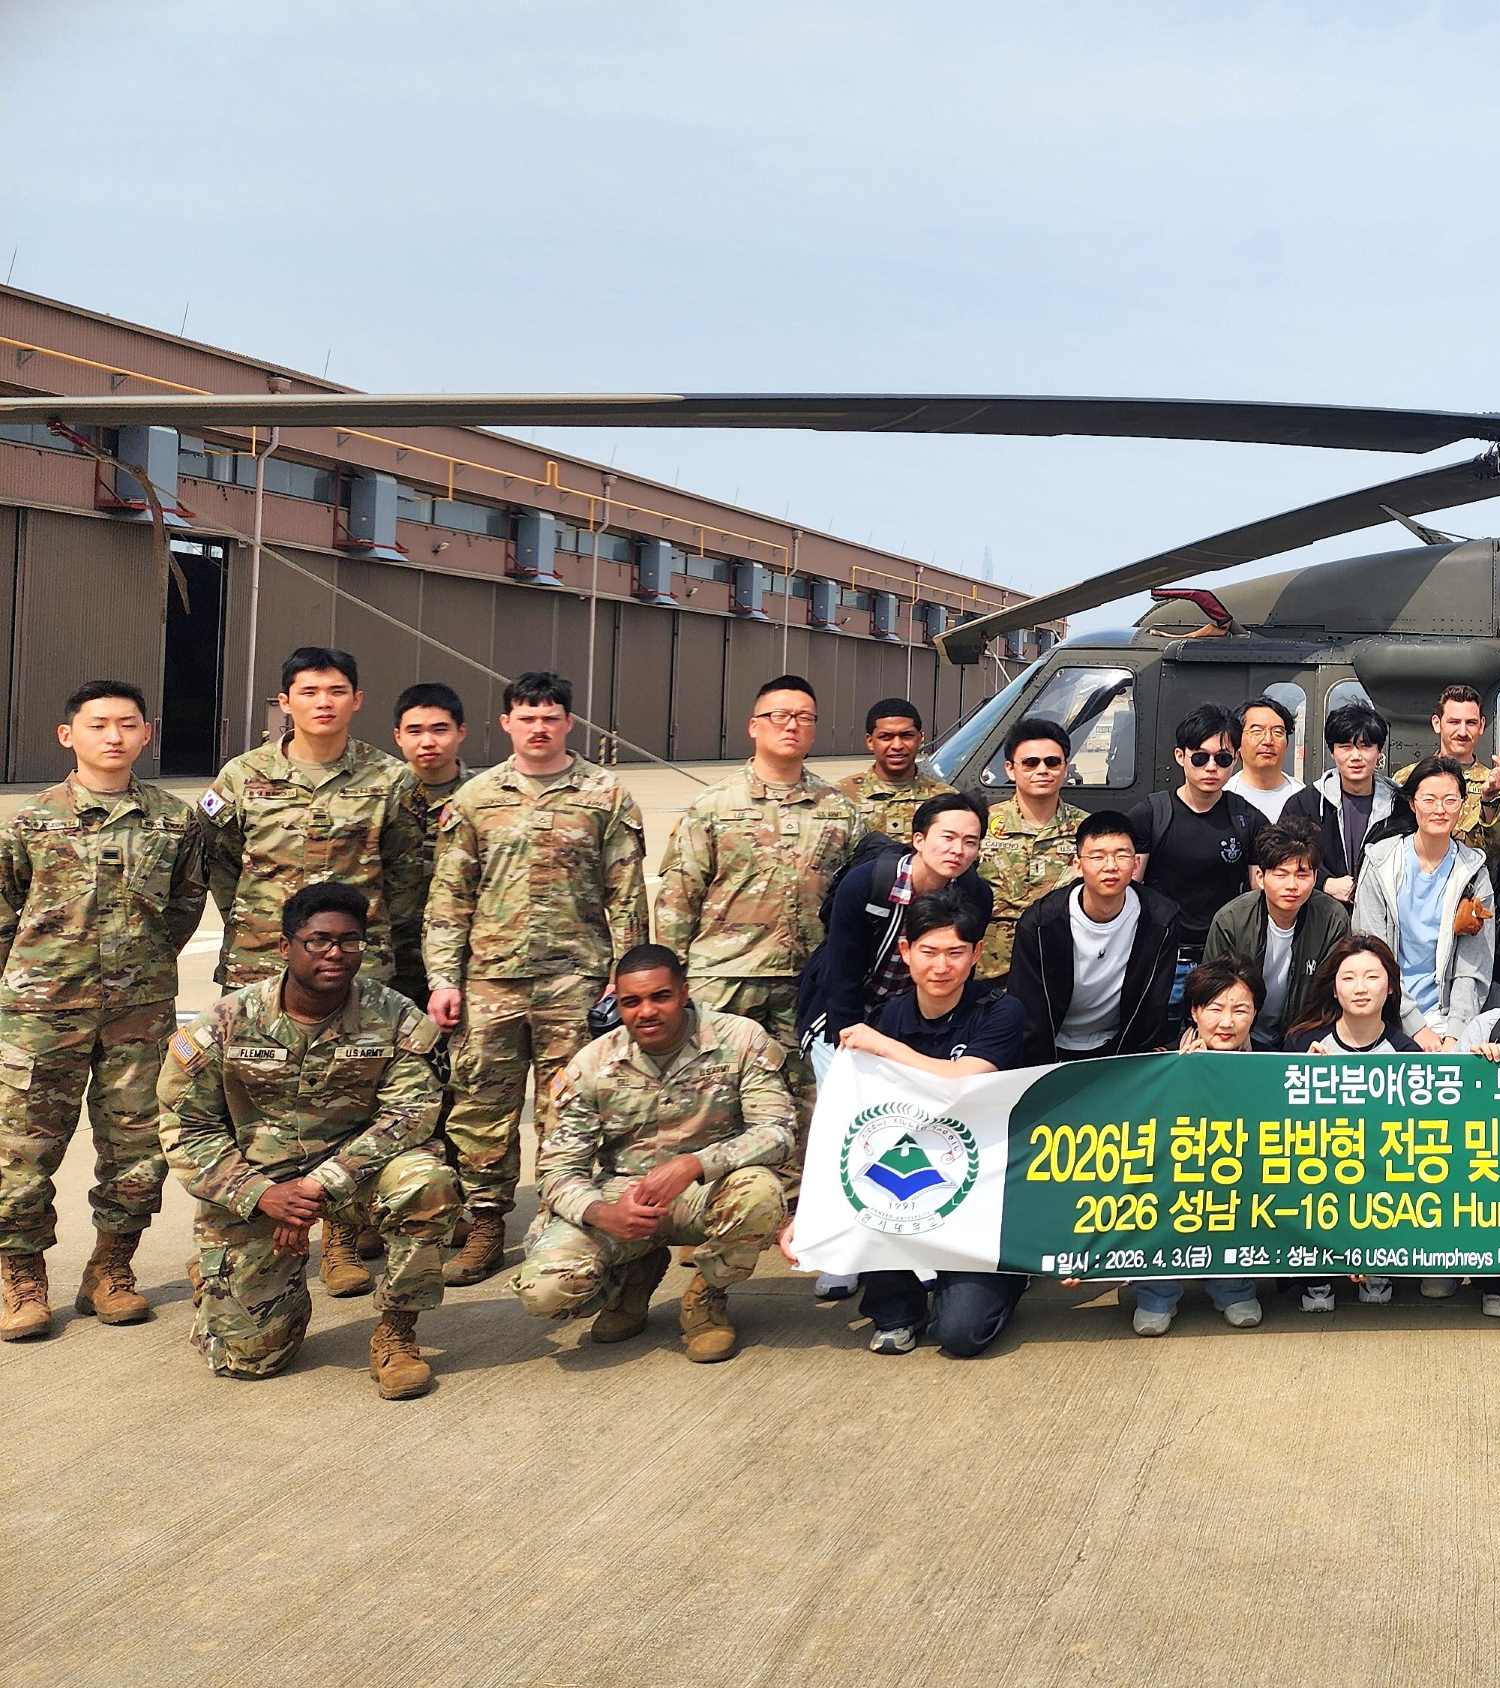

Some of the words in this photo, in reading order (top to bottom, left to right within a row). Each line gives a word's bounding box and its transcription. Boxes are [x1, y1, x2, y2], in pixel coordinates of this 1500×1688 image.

[239, 1048, 275, 1059] FLEMING
[1284, 1063, 1463, 1106] 첨단분야(항공
[1026, 1118, 1158, 1185] 2026년
[1170, 1116, 1249, 1185] 현장
[1259, 1118, 1365, 1185] 탐방형
[1379, 1118, 1452, 1184] 전공
[1464, 1118, 1500, 1183] 및
[1073, 1193, 1158, 1233] 2026
[1168, 1189, 1241, 1233] 성남
[1252, 1191, 1339, 1230] K-16
[1350, 1191, 1442, 1229] USAG
[1105, 1251, 1148, 1270] 2026.
[1152, 1249, 1167, 1268] 4.
[1171, 1246, 1213, 1270] 3.(금)
[1287, 1246, 1318, 1267] 성남
[1322, 1247, 1362, 1266] K-16
[1365, 1248, 1409, 1267] USAG
[1412, 1248, 1494, 1270] Humphreys
